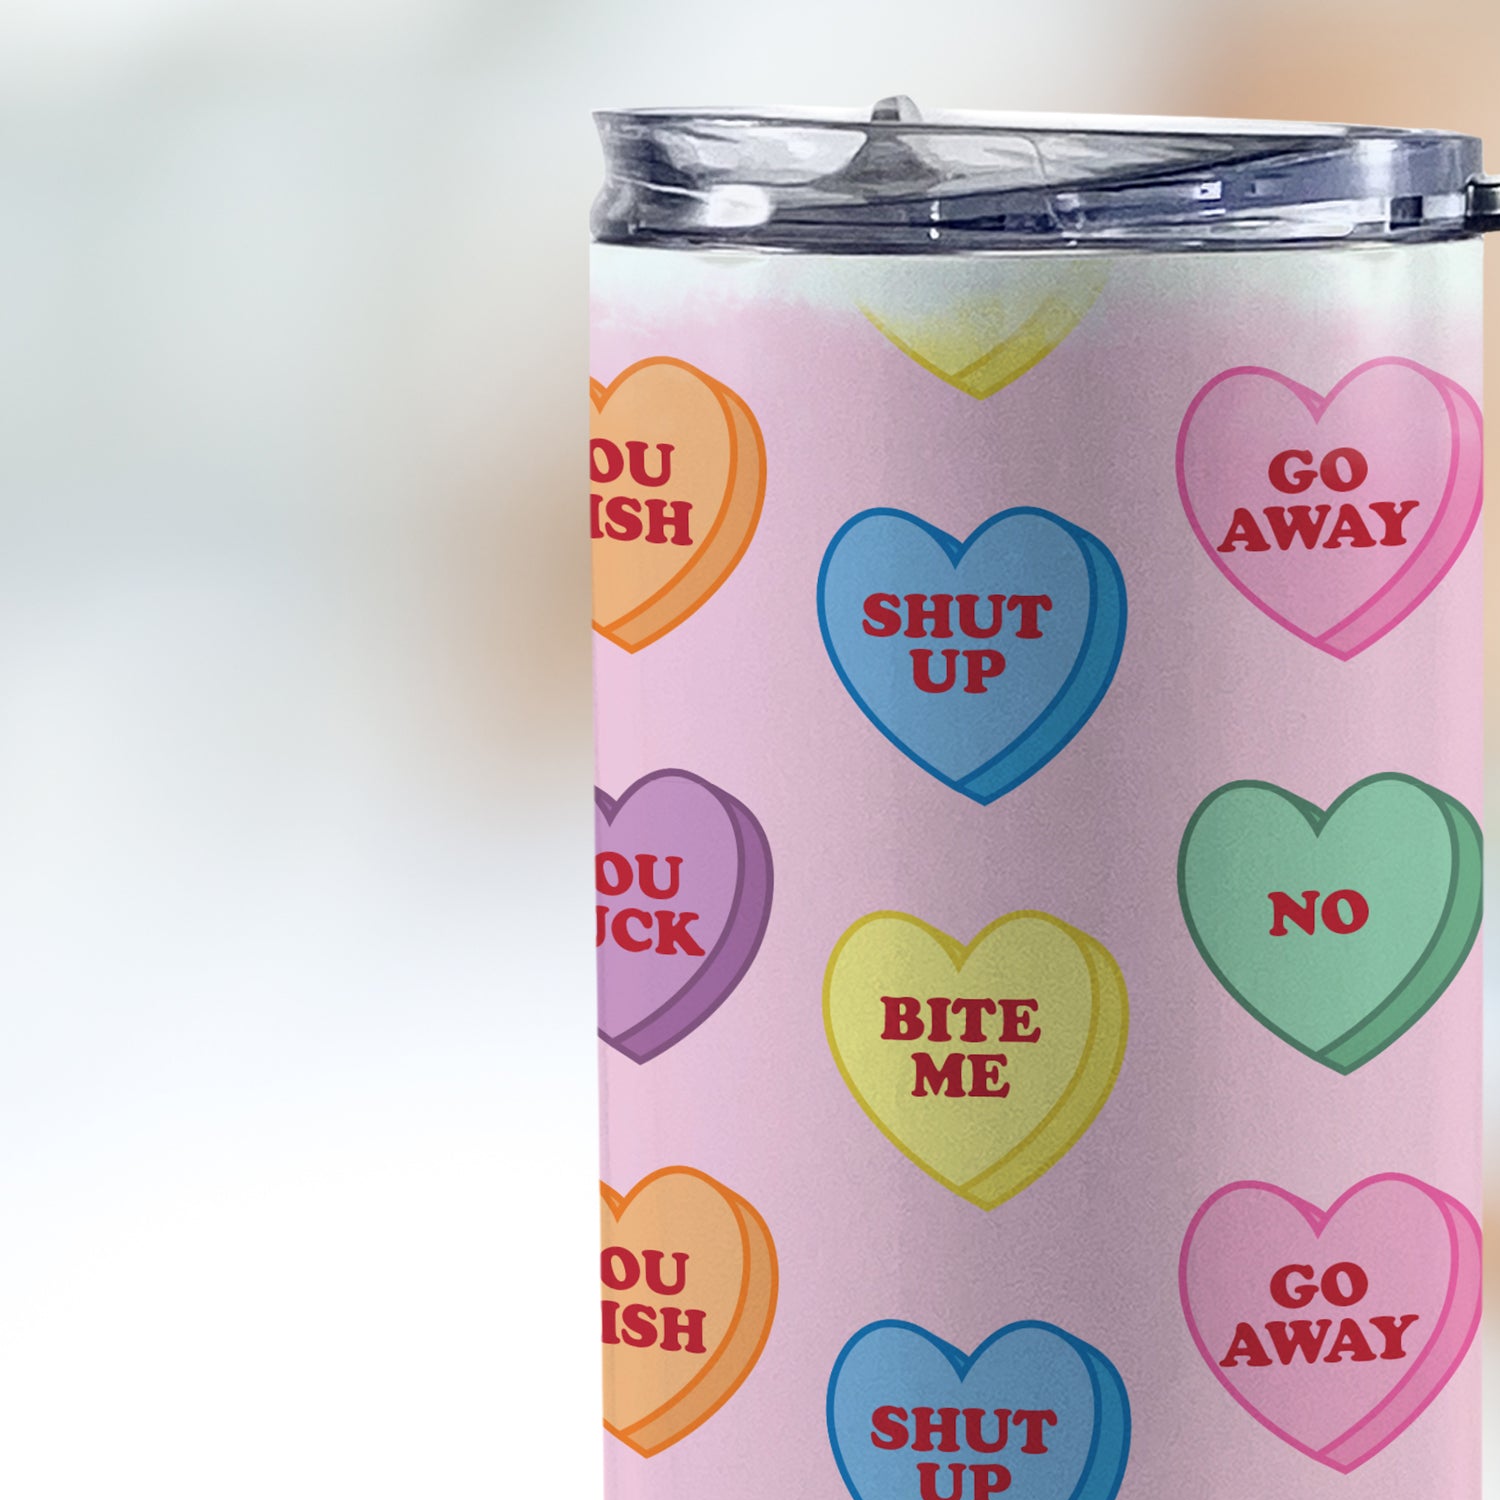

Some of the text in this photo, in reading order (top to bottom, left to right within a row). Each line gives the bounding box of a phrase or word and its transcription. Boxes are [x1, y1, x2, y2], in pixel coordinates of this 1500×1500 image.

[1267, 447, 1368, 495] GO
[1216, 500, 1420, 553] AWAY
[862, 593, 1052, 639] SHUT
[909, 649, 1006, 694] UP
[1268, 889, 1369, 937] NO
[880, 996, 1041, 1043] BITE
[911, 1052, 1010, 1098] ME
[1269, 1261, 1369, 1310] GO
[1218, 1314, 1420, 1368] AWAY
[871, 1405, 1057, 1454] SHUT
